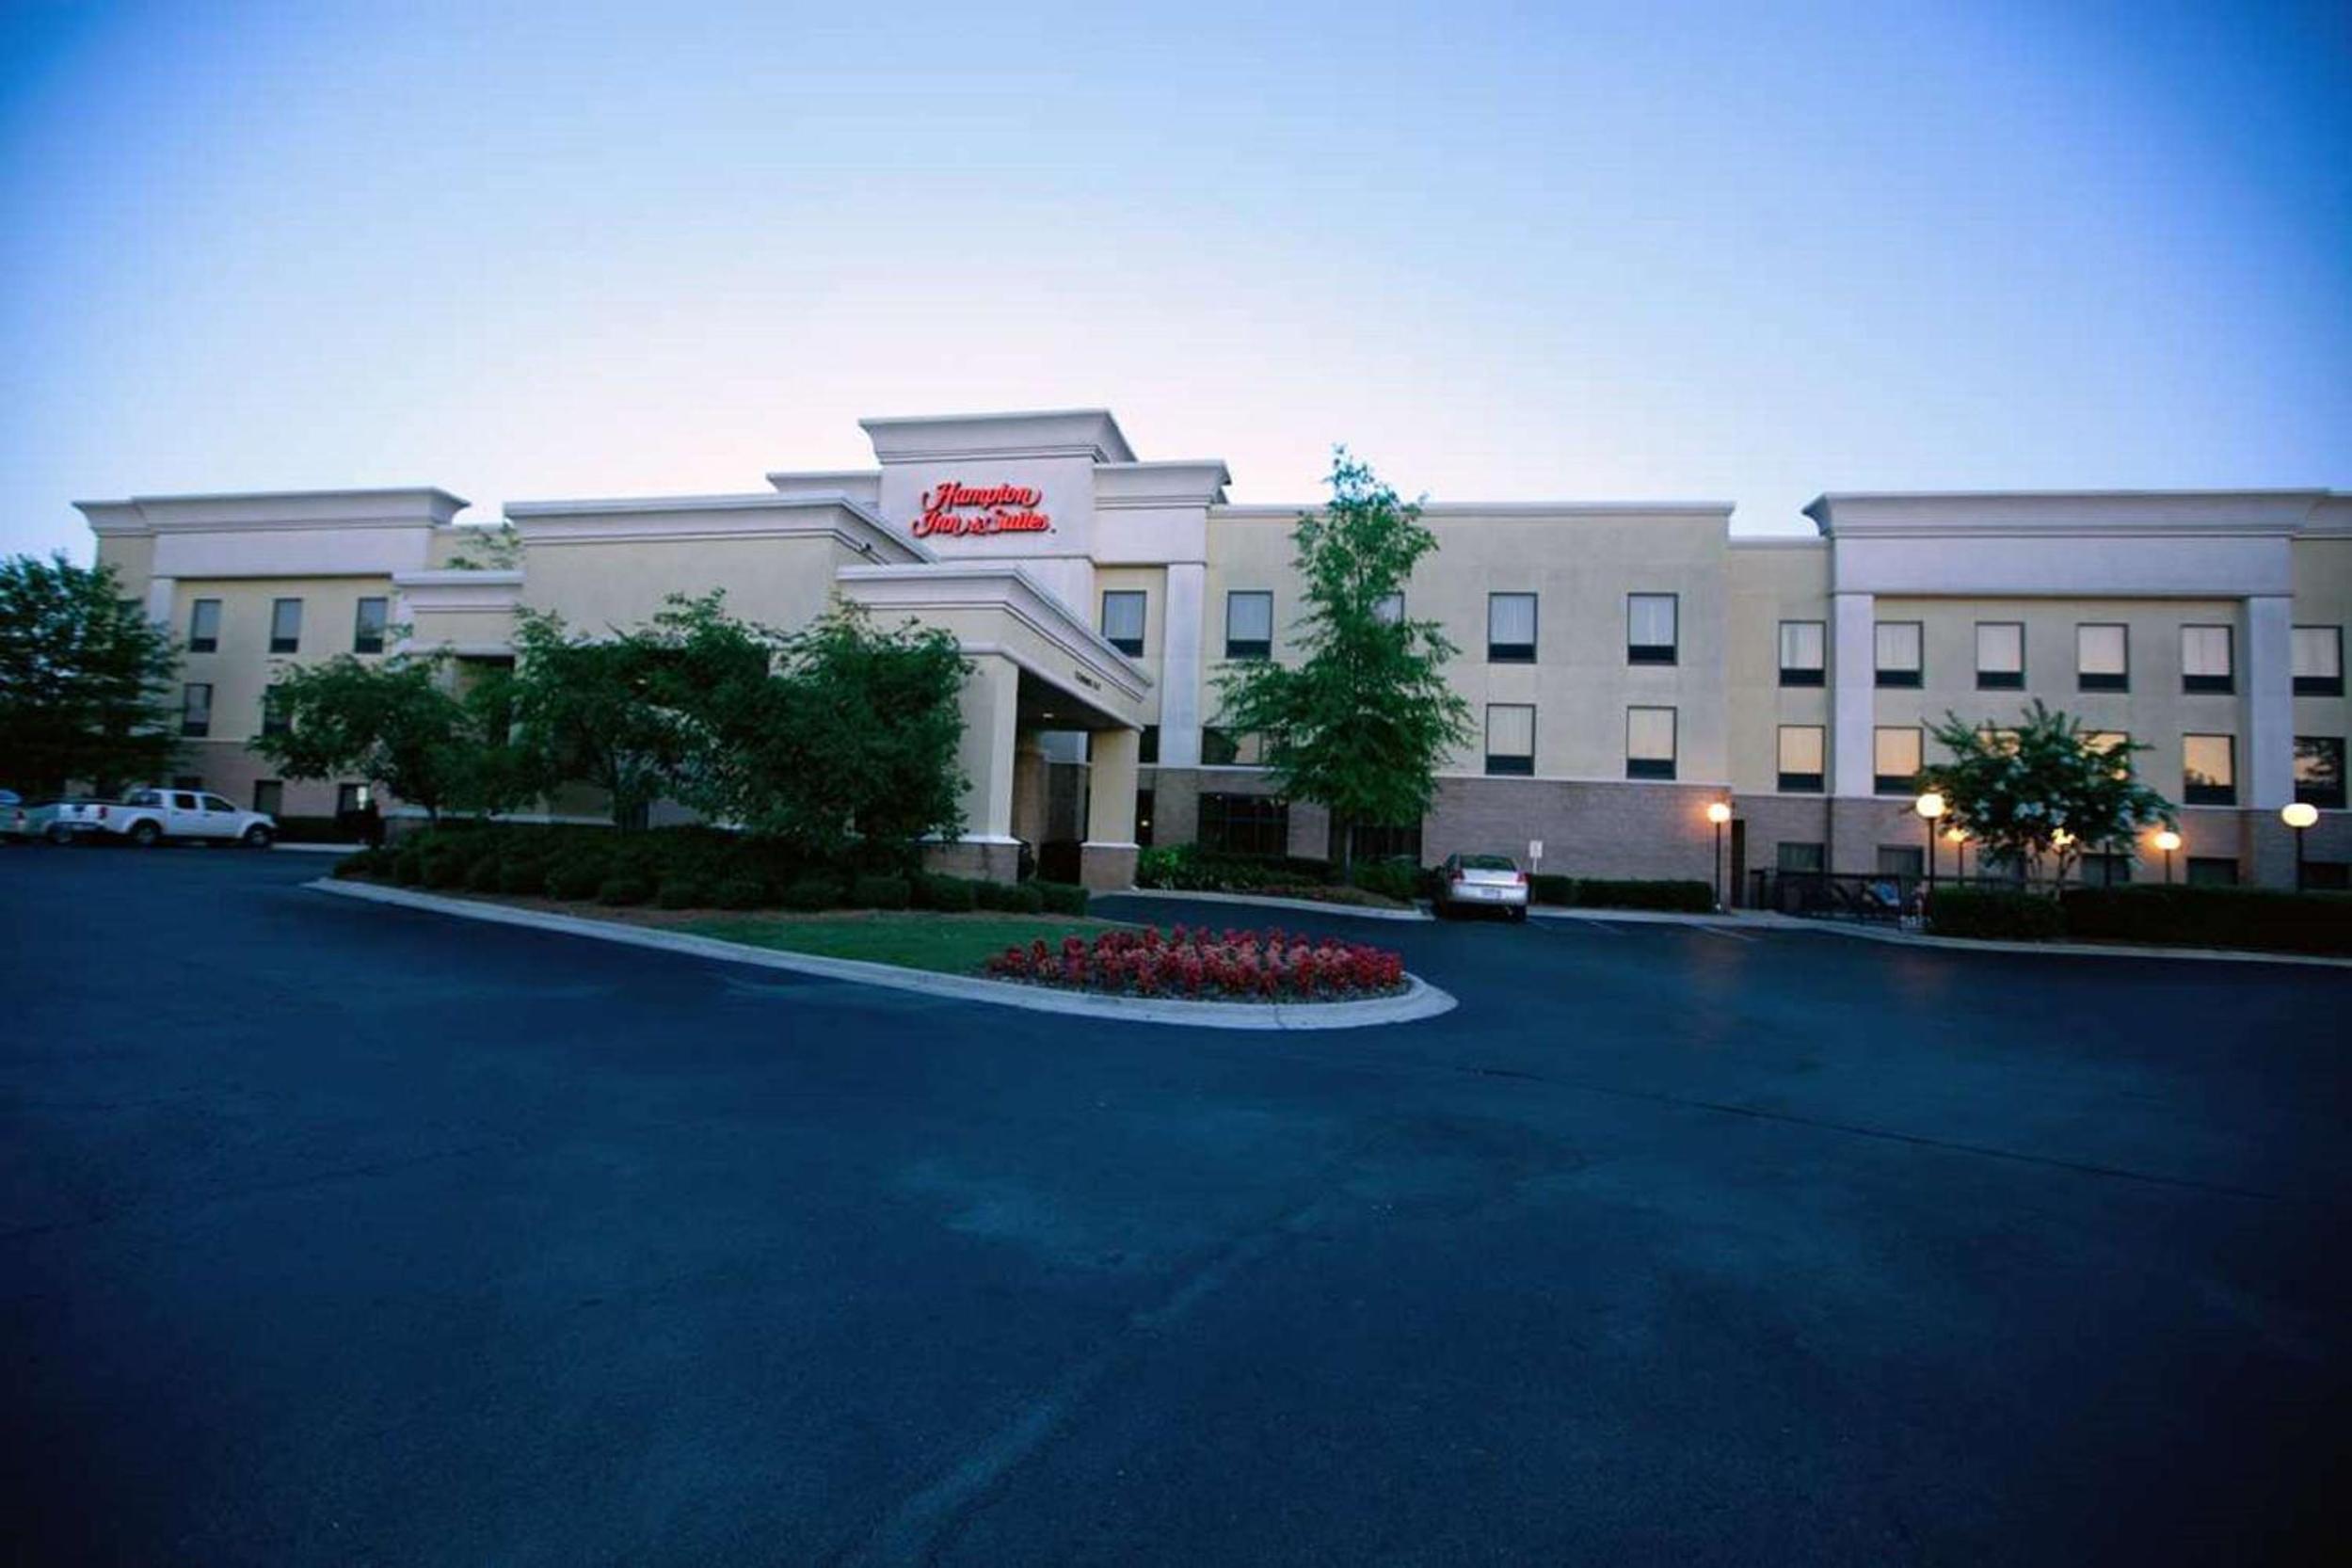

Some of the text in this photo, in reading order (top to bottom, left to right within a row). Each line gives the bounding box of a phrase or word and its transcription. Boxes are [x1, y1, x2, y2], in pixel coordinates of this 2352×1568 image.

[922, 482, 1042, 512] Hampton
[913, 510, 970, 537] Inn
[985, 509, 1049, 534] Suites
